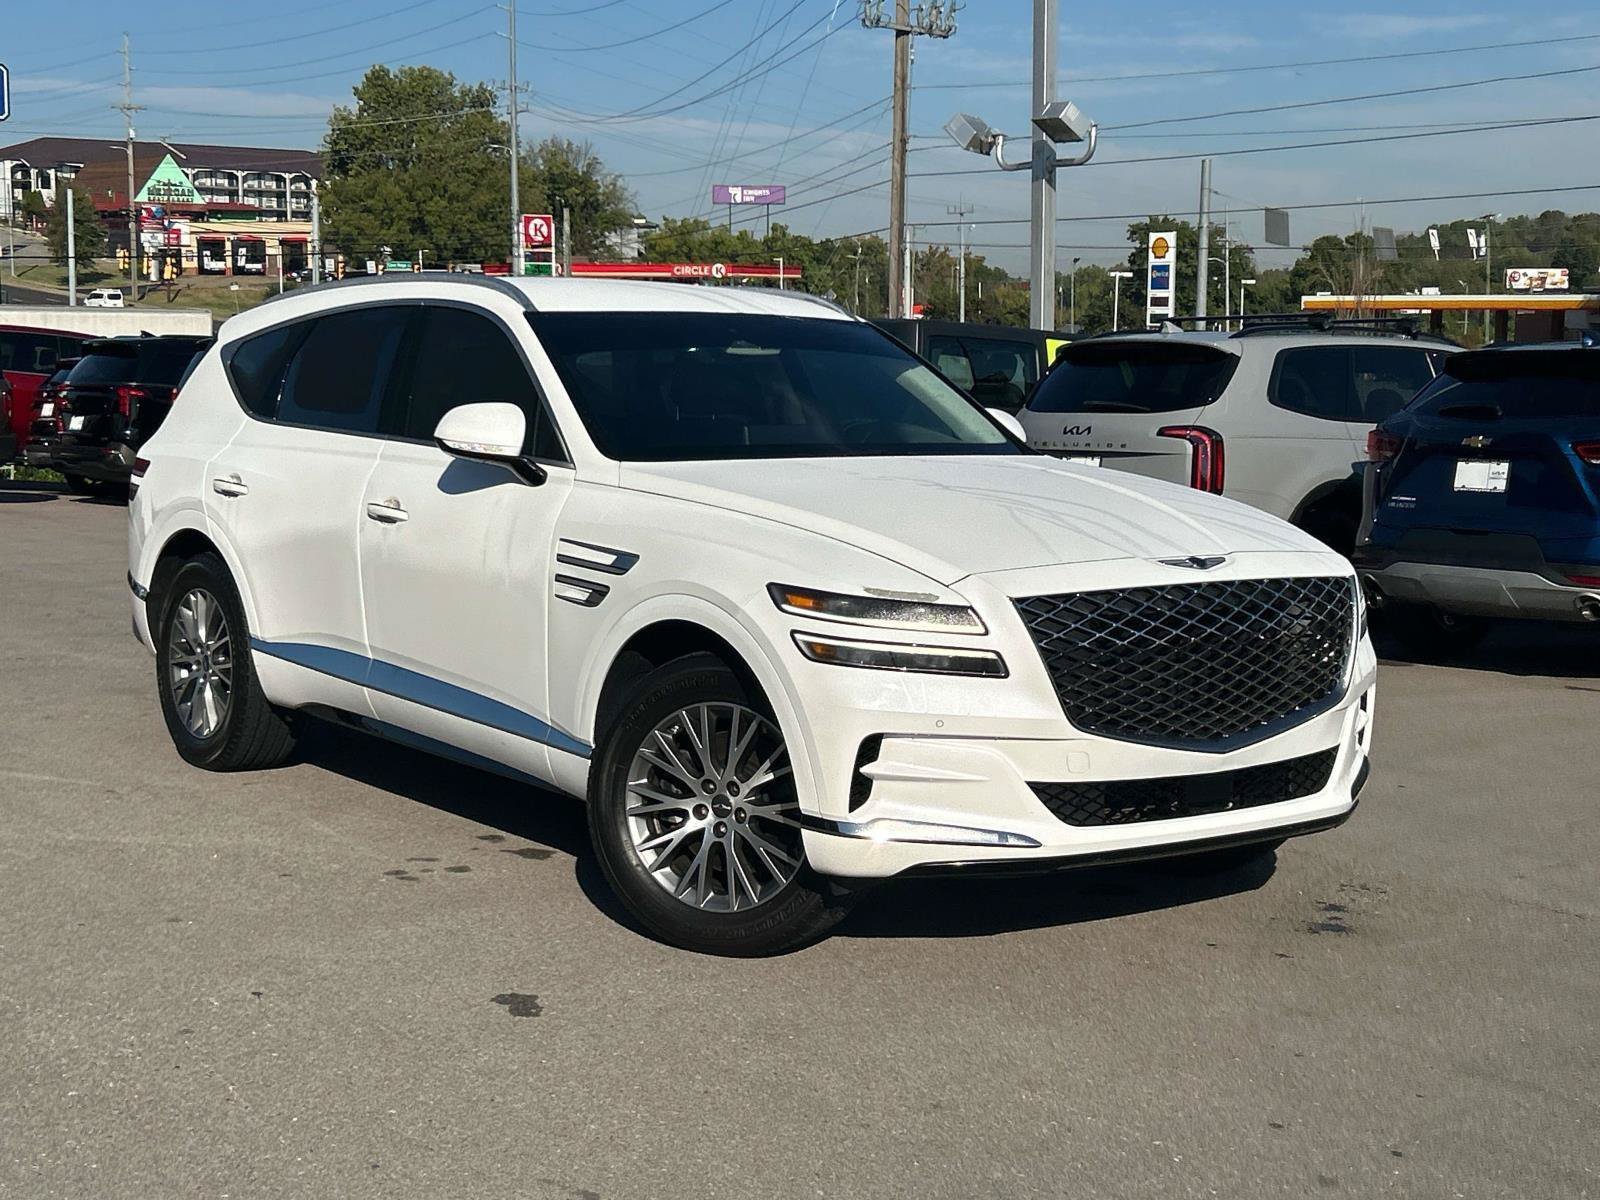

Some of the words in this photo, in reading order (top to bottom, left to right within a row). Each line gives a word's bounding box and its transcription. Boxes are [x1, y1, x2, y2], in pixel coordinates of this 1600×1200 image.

[147, 186, 194, 197] MEXCAN
[531, 221, 548, 240] K
[673, 265, 711, 276] CIRCLE
[714, 265, 725, 277] K
[1063, 425, 1092, 435] KIA
[1033, 441, 1127, 449] TELLURIDE
